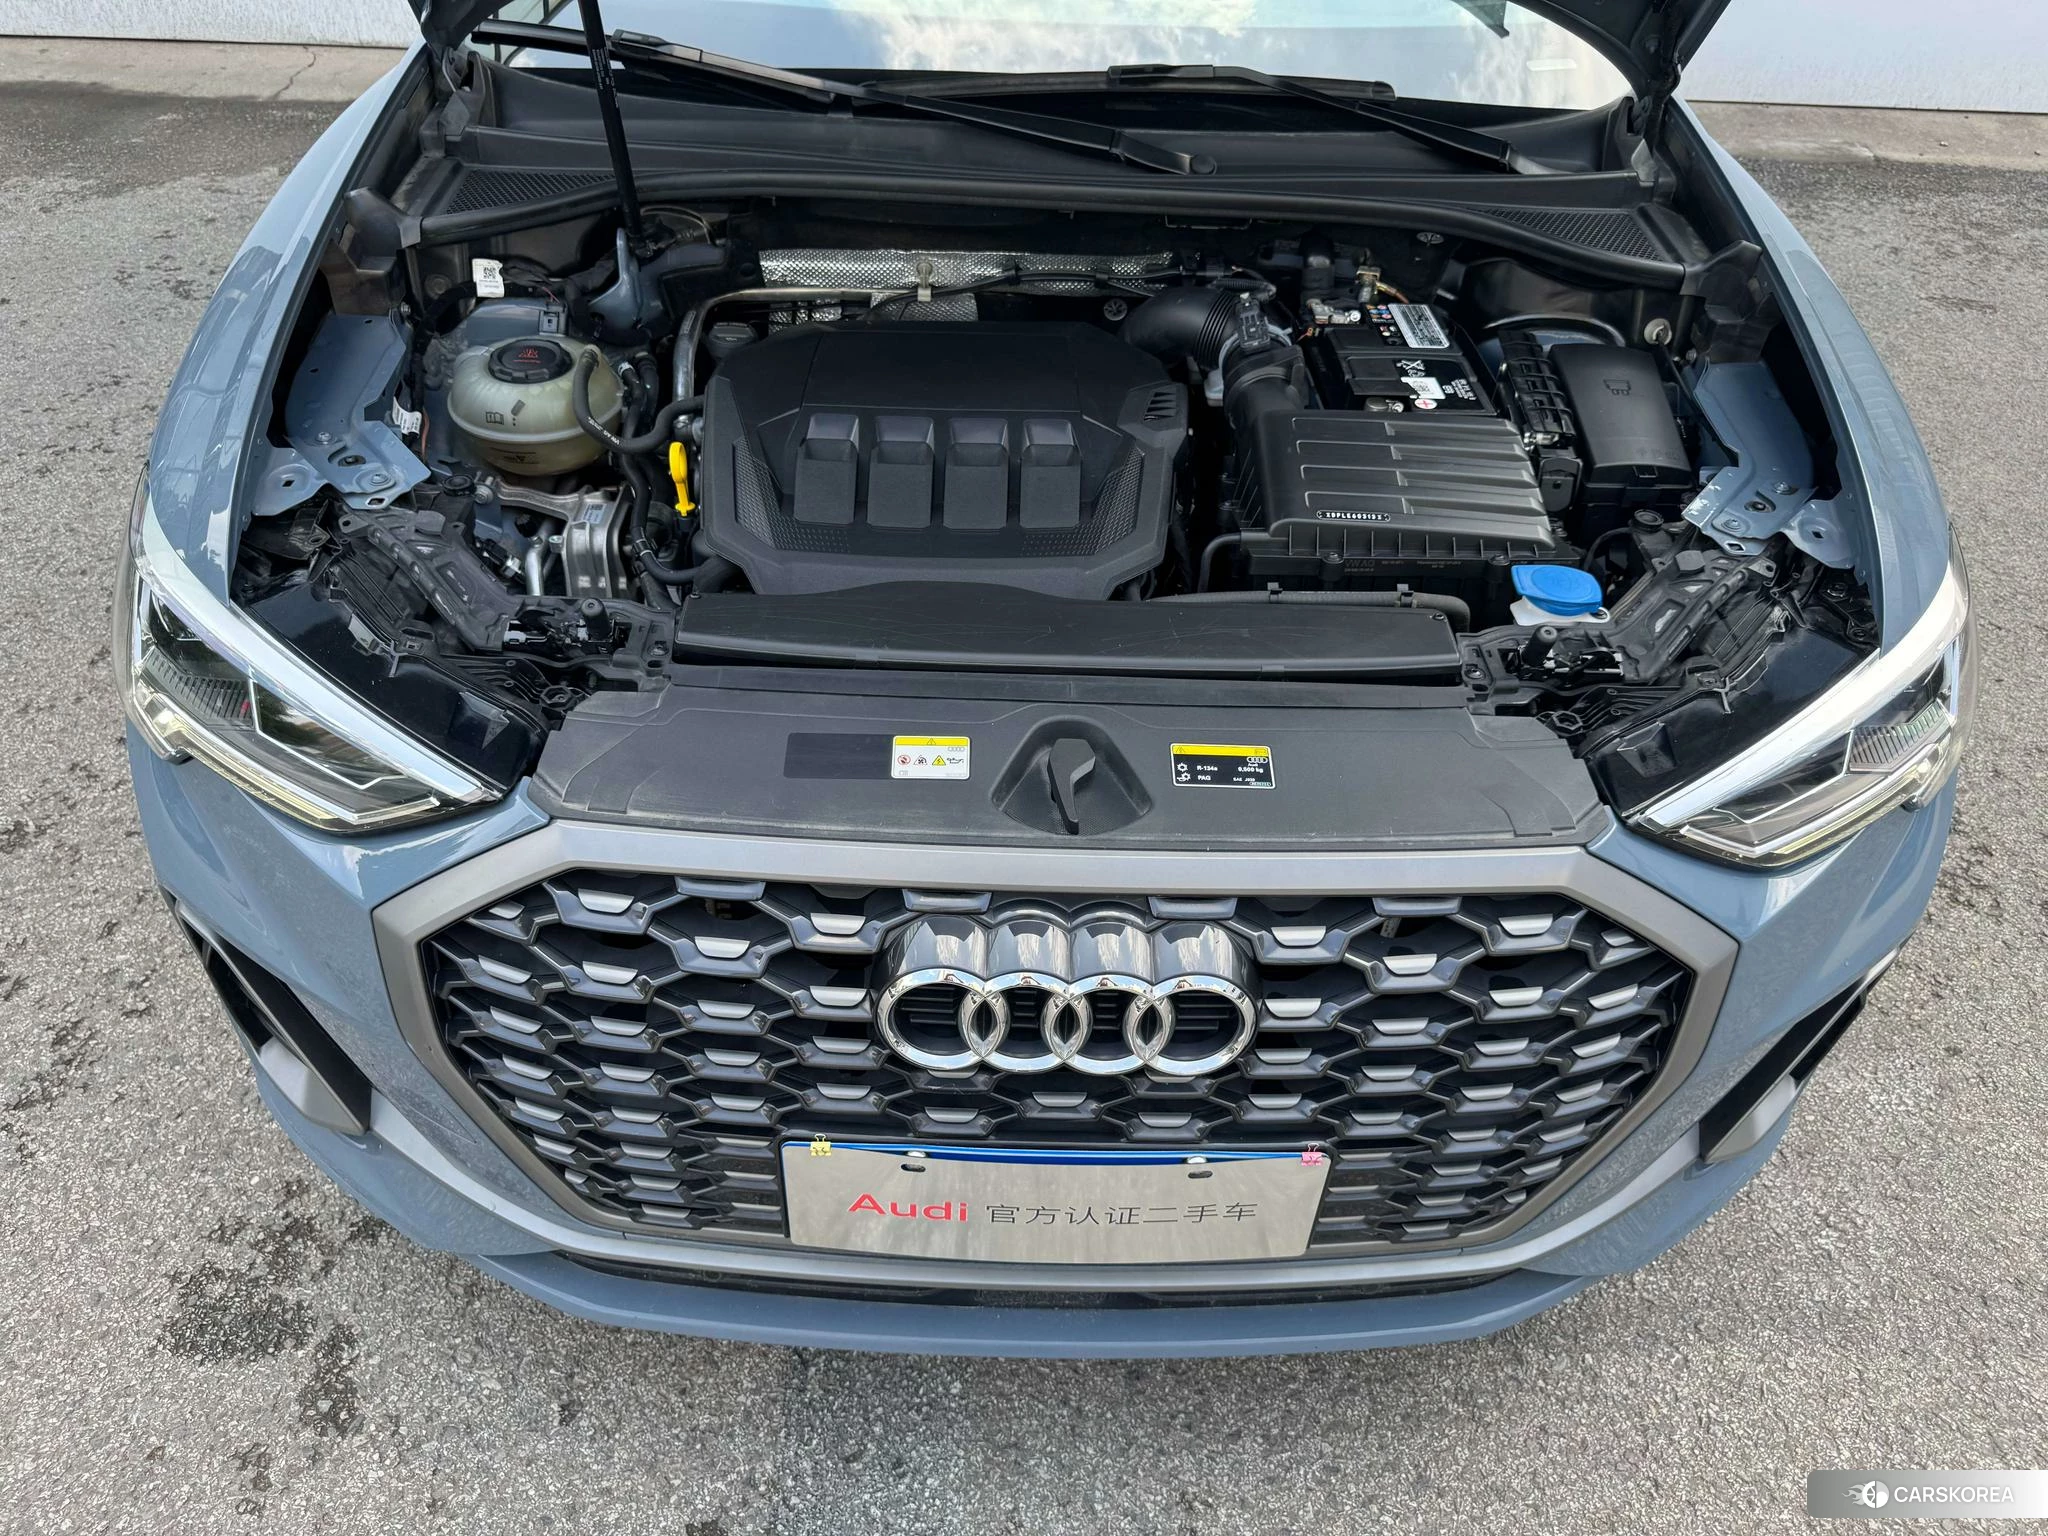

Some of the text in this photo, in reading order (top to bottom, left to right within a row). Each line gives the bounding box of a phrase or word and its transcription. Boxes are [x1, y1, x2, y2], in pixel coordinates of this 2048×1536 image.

[848, 1193, 1258, 1225] Audi 官方认证二手车
